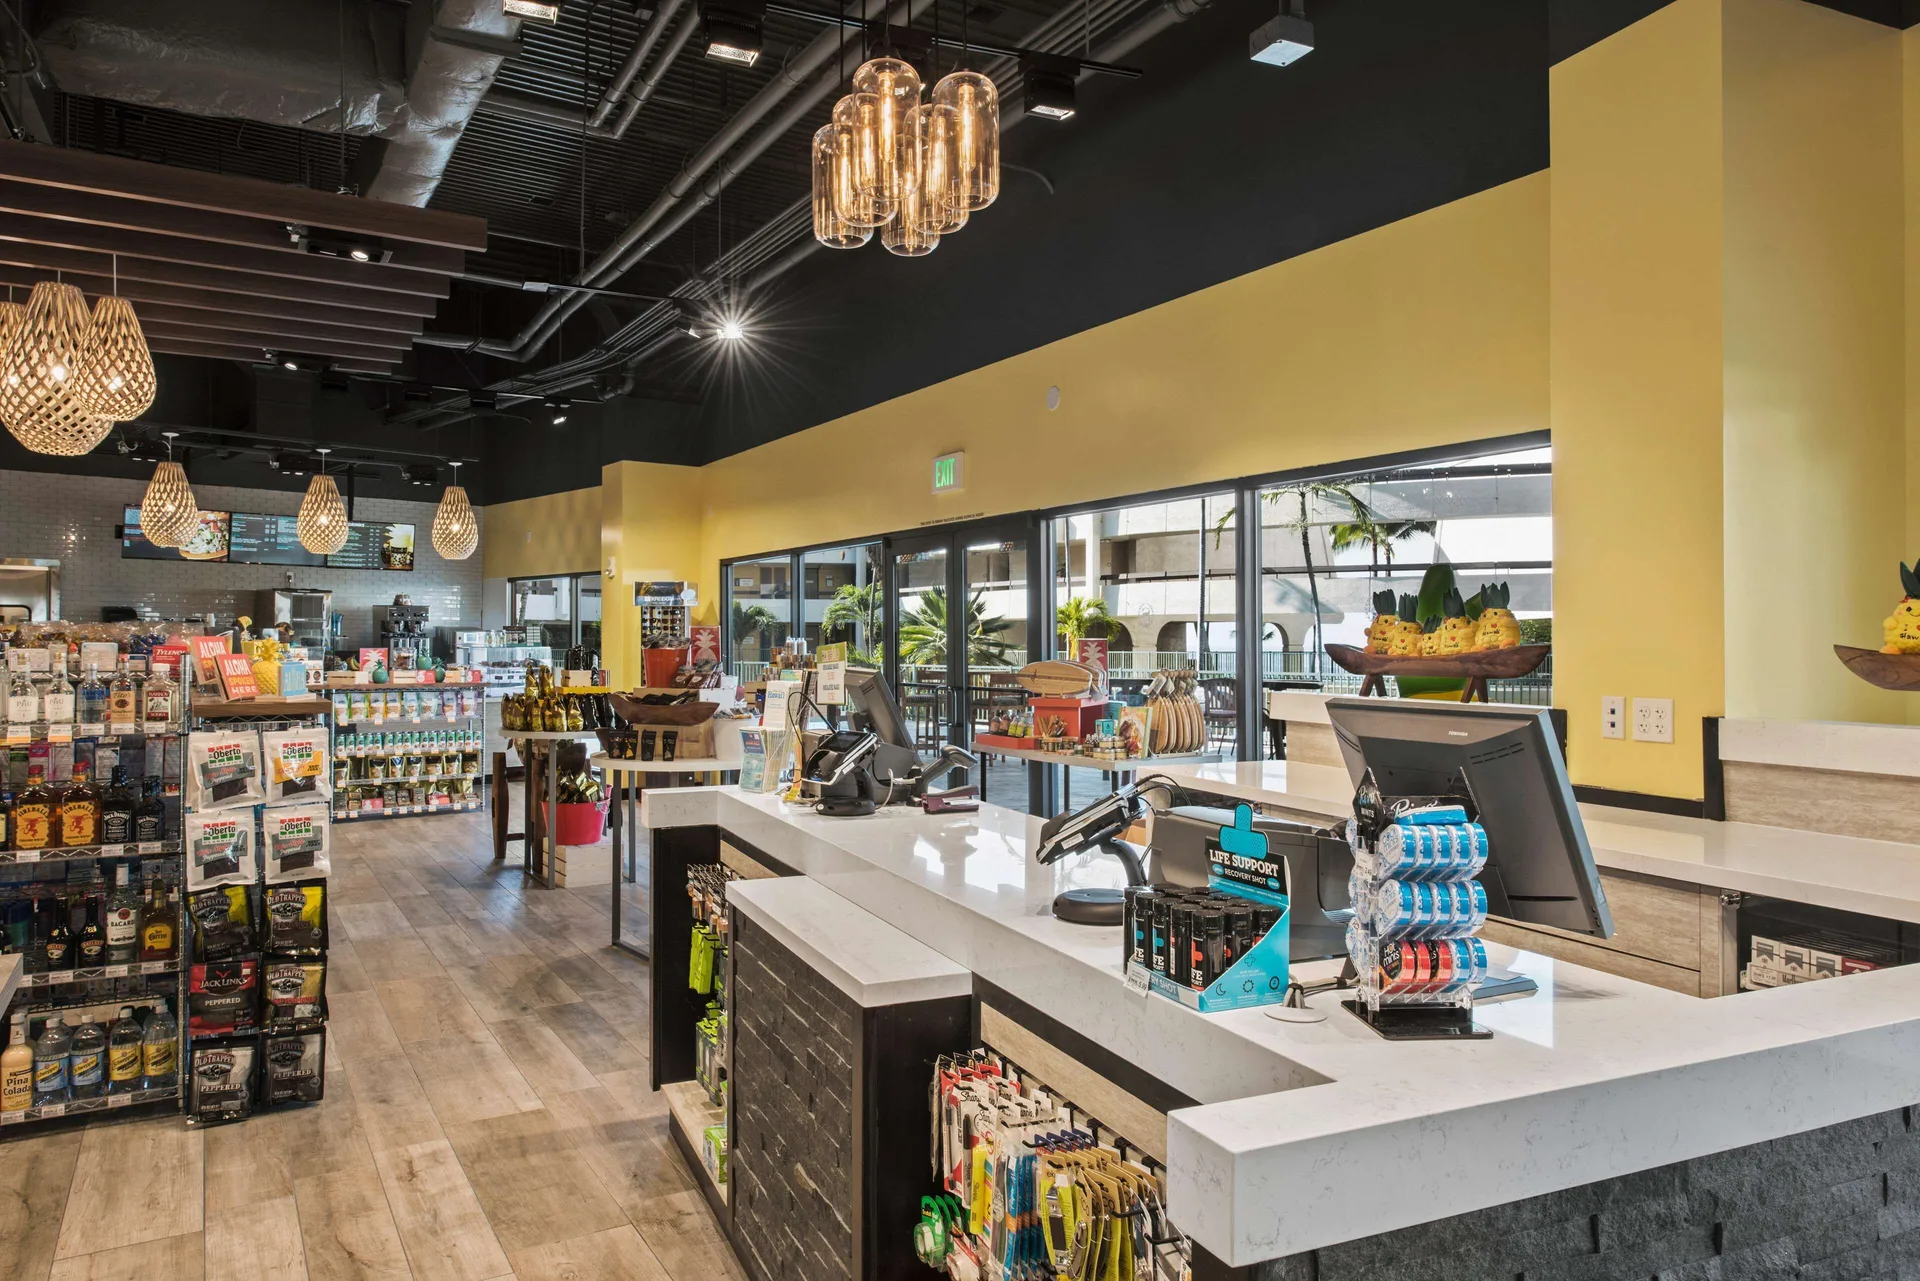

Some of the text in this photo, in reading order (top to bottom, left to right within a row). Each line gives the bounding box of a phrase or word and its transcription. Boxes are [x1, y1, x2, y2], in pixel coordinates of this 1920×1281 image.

[935, 457, 955, 488] EXIT
[200, 641, 226, 658] ALOHA
[224, 658, 251, 676] ALOHA
[228, 676, 254, 686] SPOKEN
[231, 686, 257, 694] HERE
[213, 748, 241, 760] Oberto
[286, 746, 312, 756] Oberto
[18, 805, 49, 817] FIREBALL
[63, 803, 94, 815] FIREBALL
[208, 826, 236, 836] Oberto
[284, 821, 311, 831] Oberto
[1209, 849, 1230, 865] LIFE
[1231, 853, 1279, 877] SUPPORT
[1224, 868, 1251, 881] RECOVERY
[1251, 875, 1266, 885] SHOT
[267, 893, 306, 905] OLD TRAPPER
[110, 919, 135, 927] BACARD
[267, 969, 307, 980] OLD TRAPPER
[200, 979, 221, 989] JACK
[1159, 979, 1177, 994] SHOT
[205, 997, 241, 1006] PEPPERED
[195, 1053, 236, 1066] OLD TRAPPER
[273, 1068, 312, 1078] PEPPERED
[6, 1077, 29, 1087] Pina
[201, 1083, 241, 1092] PEPPERED
[3, 1084, 32, 1097] Colada
